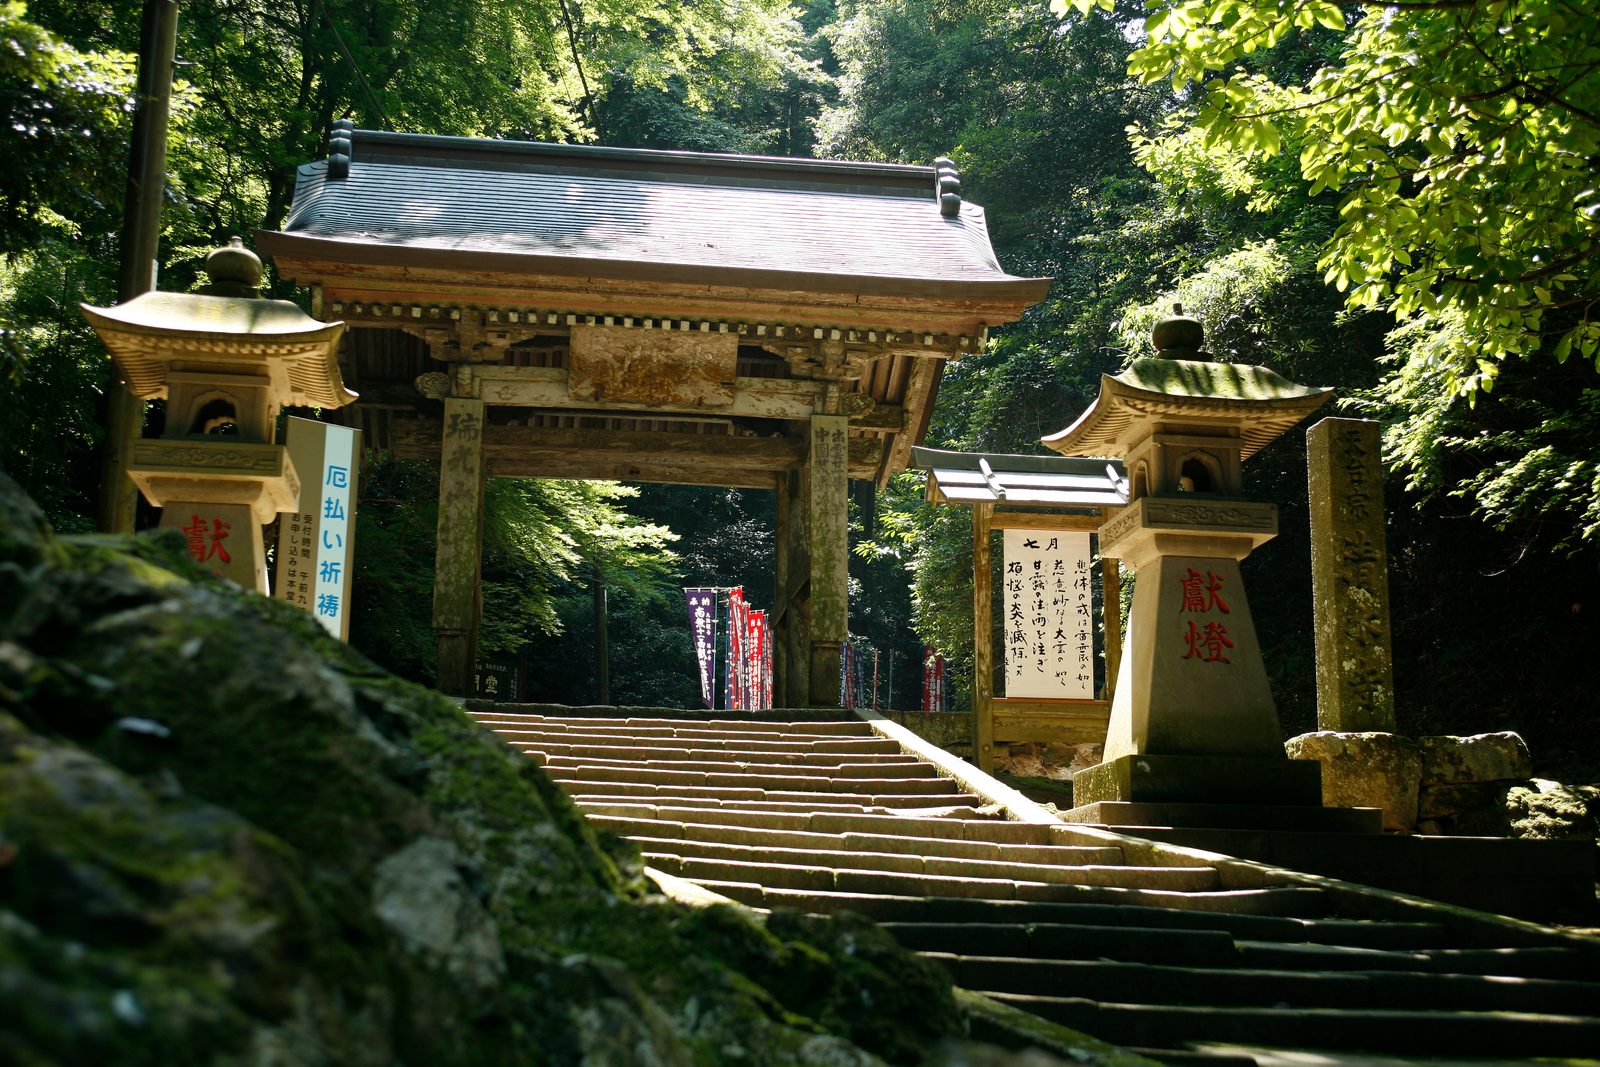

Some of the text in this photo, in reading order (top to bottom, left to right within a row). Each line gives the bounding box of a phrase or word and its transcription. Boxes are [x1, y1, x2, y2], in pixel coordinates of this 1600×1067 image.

[182, 513, 232, 574] 獻
[317, 465, 348, 618] 厄払い祈祷
[1023, 537, 1059, 551] 七月
[1342, 429, 1384, 710] 天台宗清水寺
[297, 571, 309, 611] 午前九
